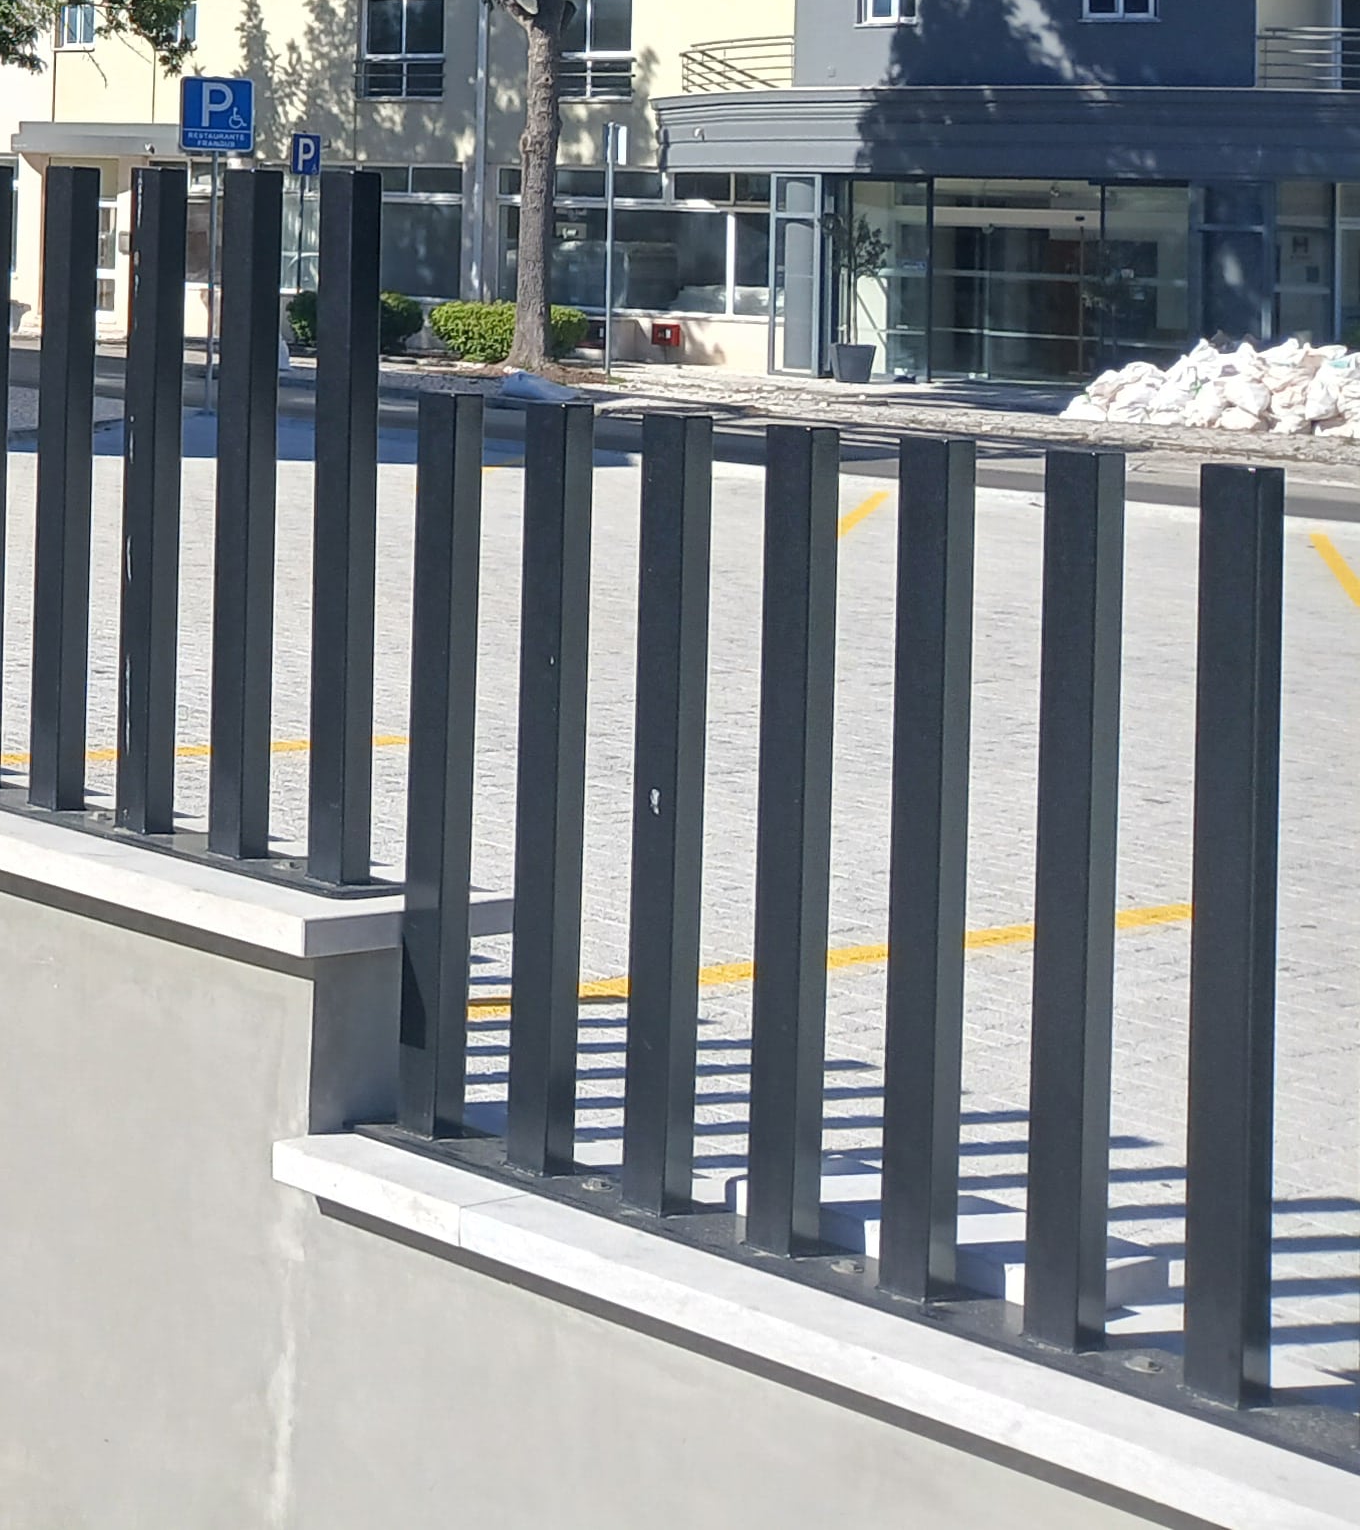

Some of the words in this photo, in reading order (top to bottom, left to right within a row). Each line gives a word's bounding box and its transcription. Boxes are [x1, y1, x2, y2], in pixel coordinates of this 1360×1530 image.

[201, 82, 233, 127] P
[188, 132, 245, 141] RESTAURANTE
[298, 138, 315, 171] P
